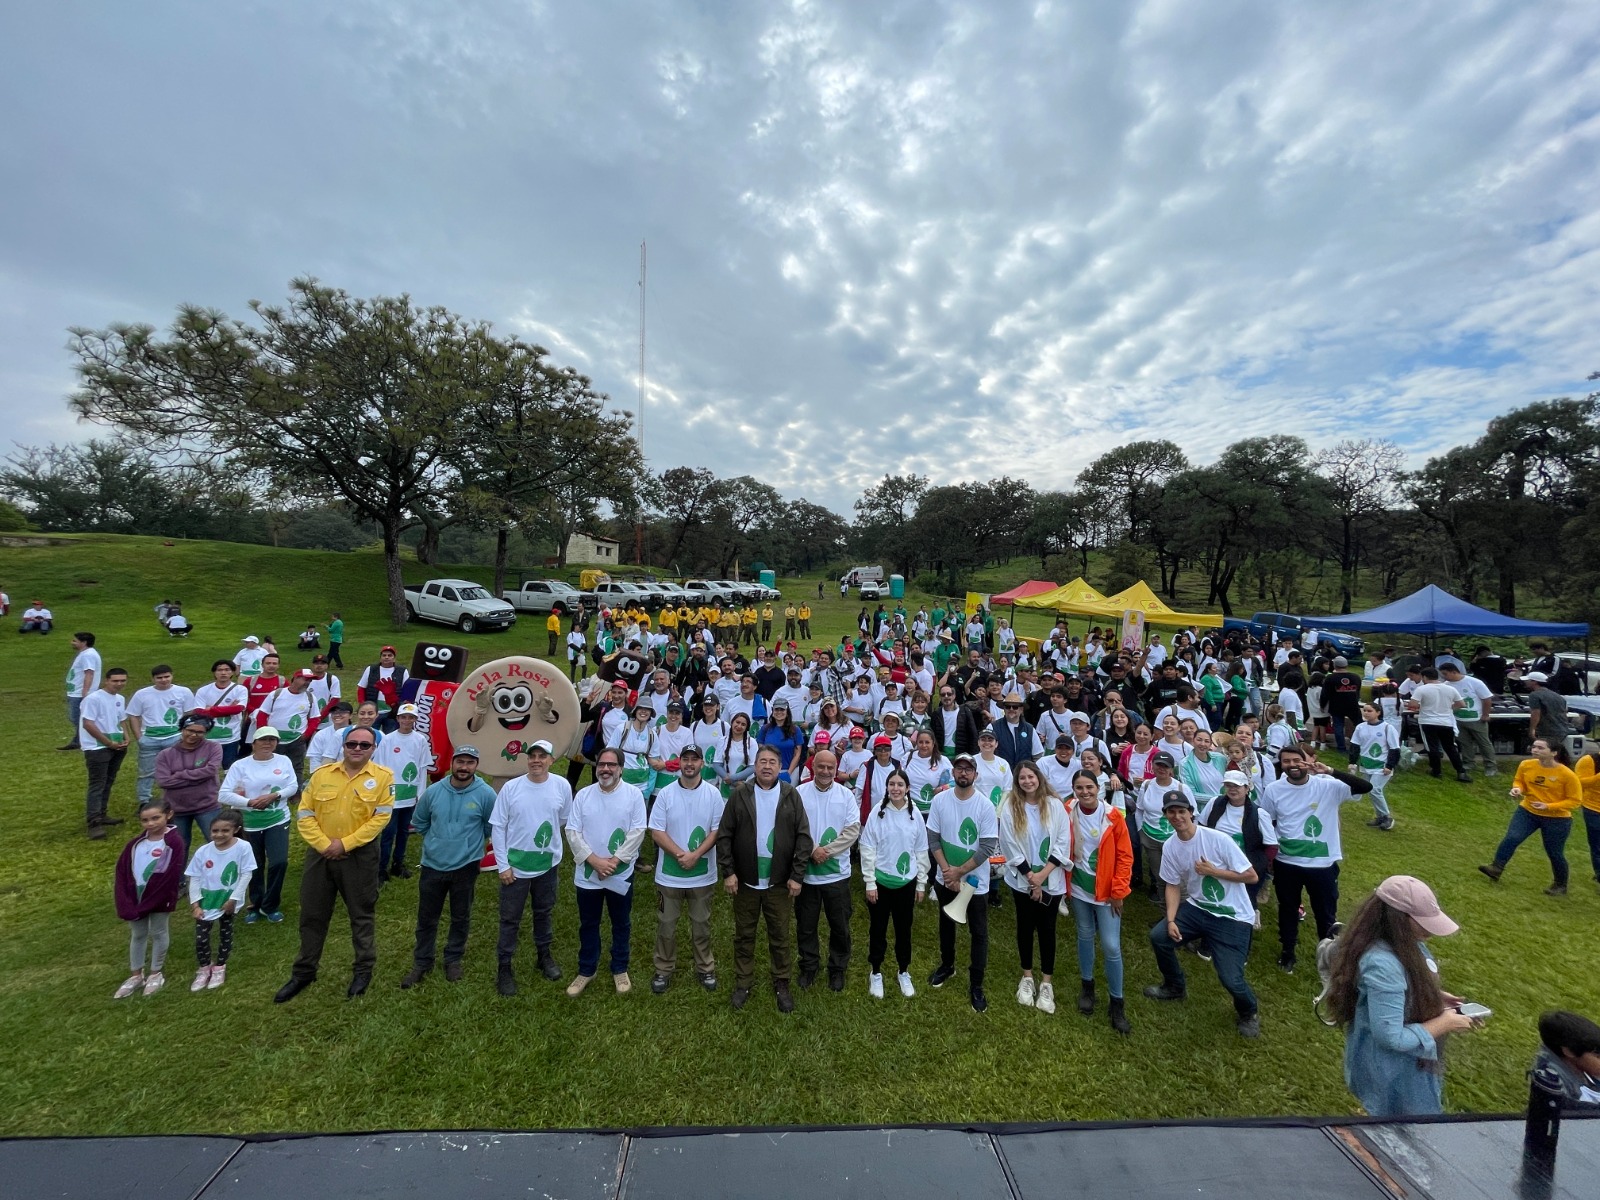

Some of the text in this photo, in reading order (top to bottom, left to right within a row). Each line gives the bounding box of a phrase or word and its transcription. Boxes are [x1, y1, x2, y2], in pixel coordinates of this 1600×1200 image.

[466, 663, 551, 702] de la Rosa
